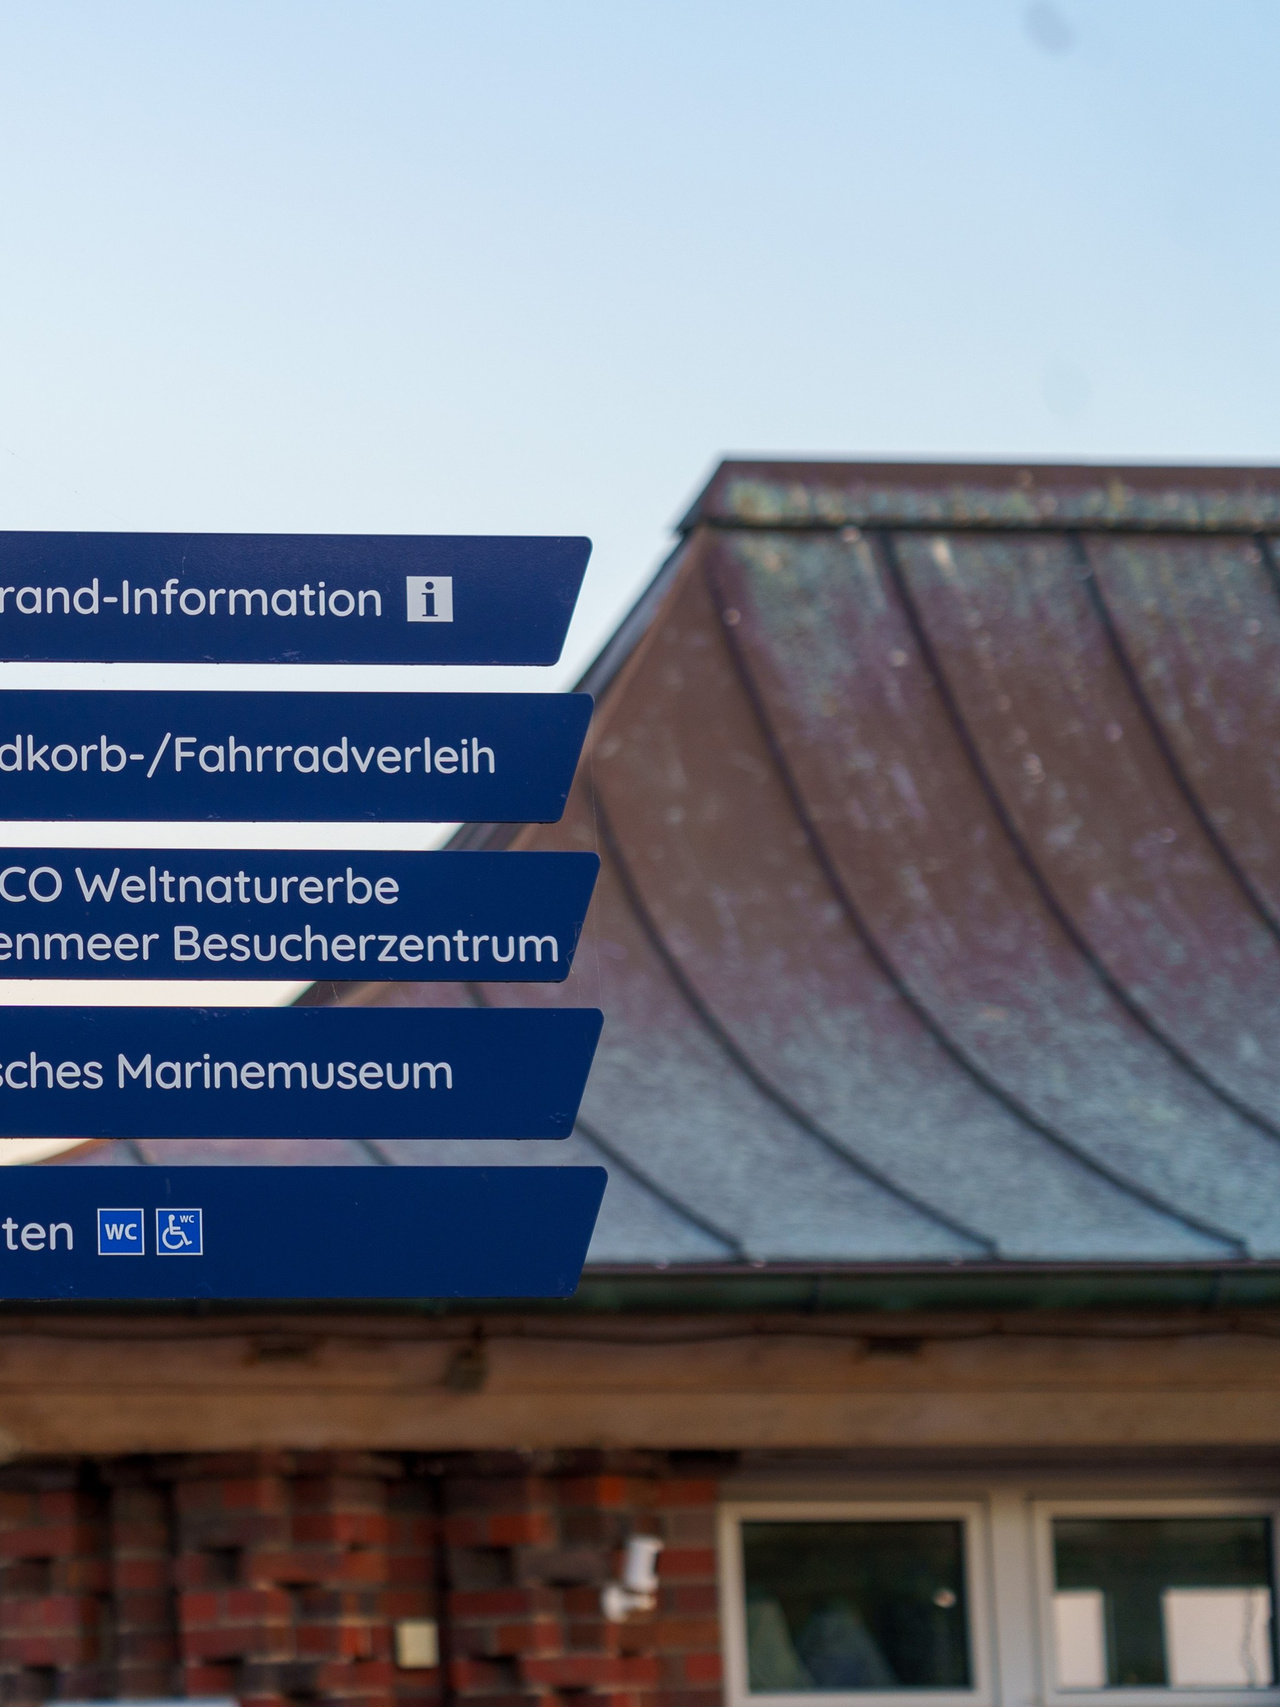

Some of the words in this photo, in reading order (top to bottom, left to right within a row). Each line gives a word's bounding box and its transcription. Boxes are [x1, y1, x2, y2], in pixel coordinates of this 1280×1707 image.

[74, 865, 400, 905] Weltnaturerbe
[173, 924, 559, 963] Besucherzentrum
[118, 1053, 453, 1090] Marinemuseum
[104, 1223, 138, 1240] WC
[179, 1214, 195, 1224] WC
